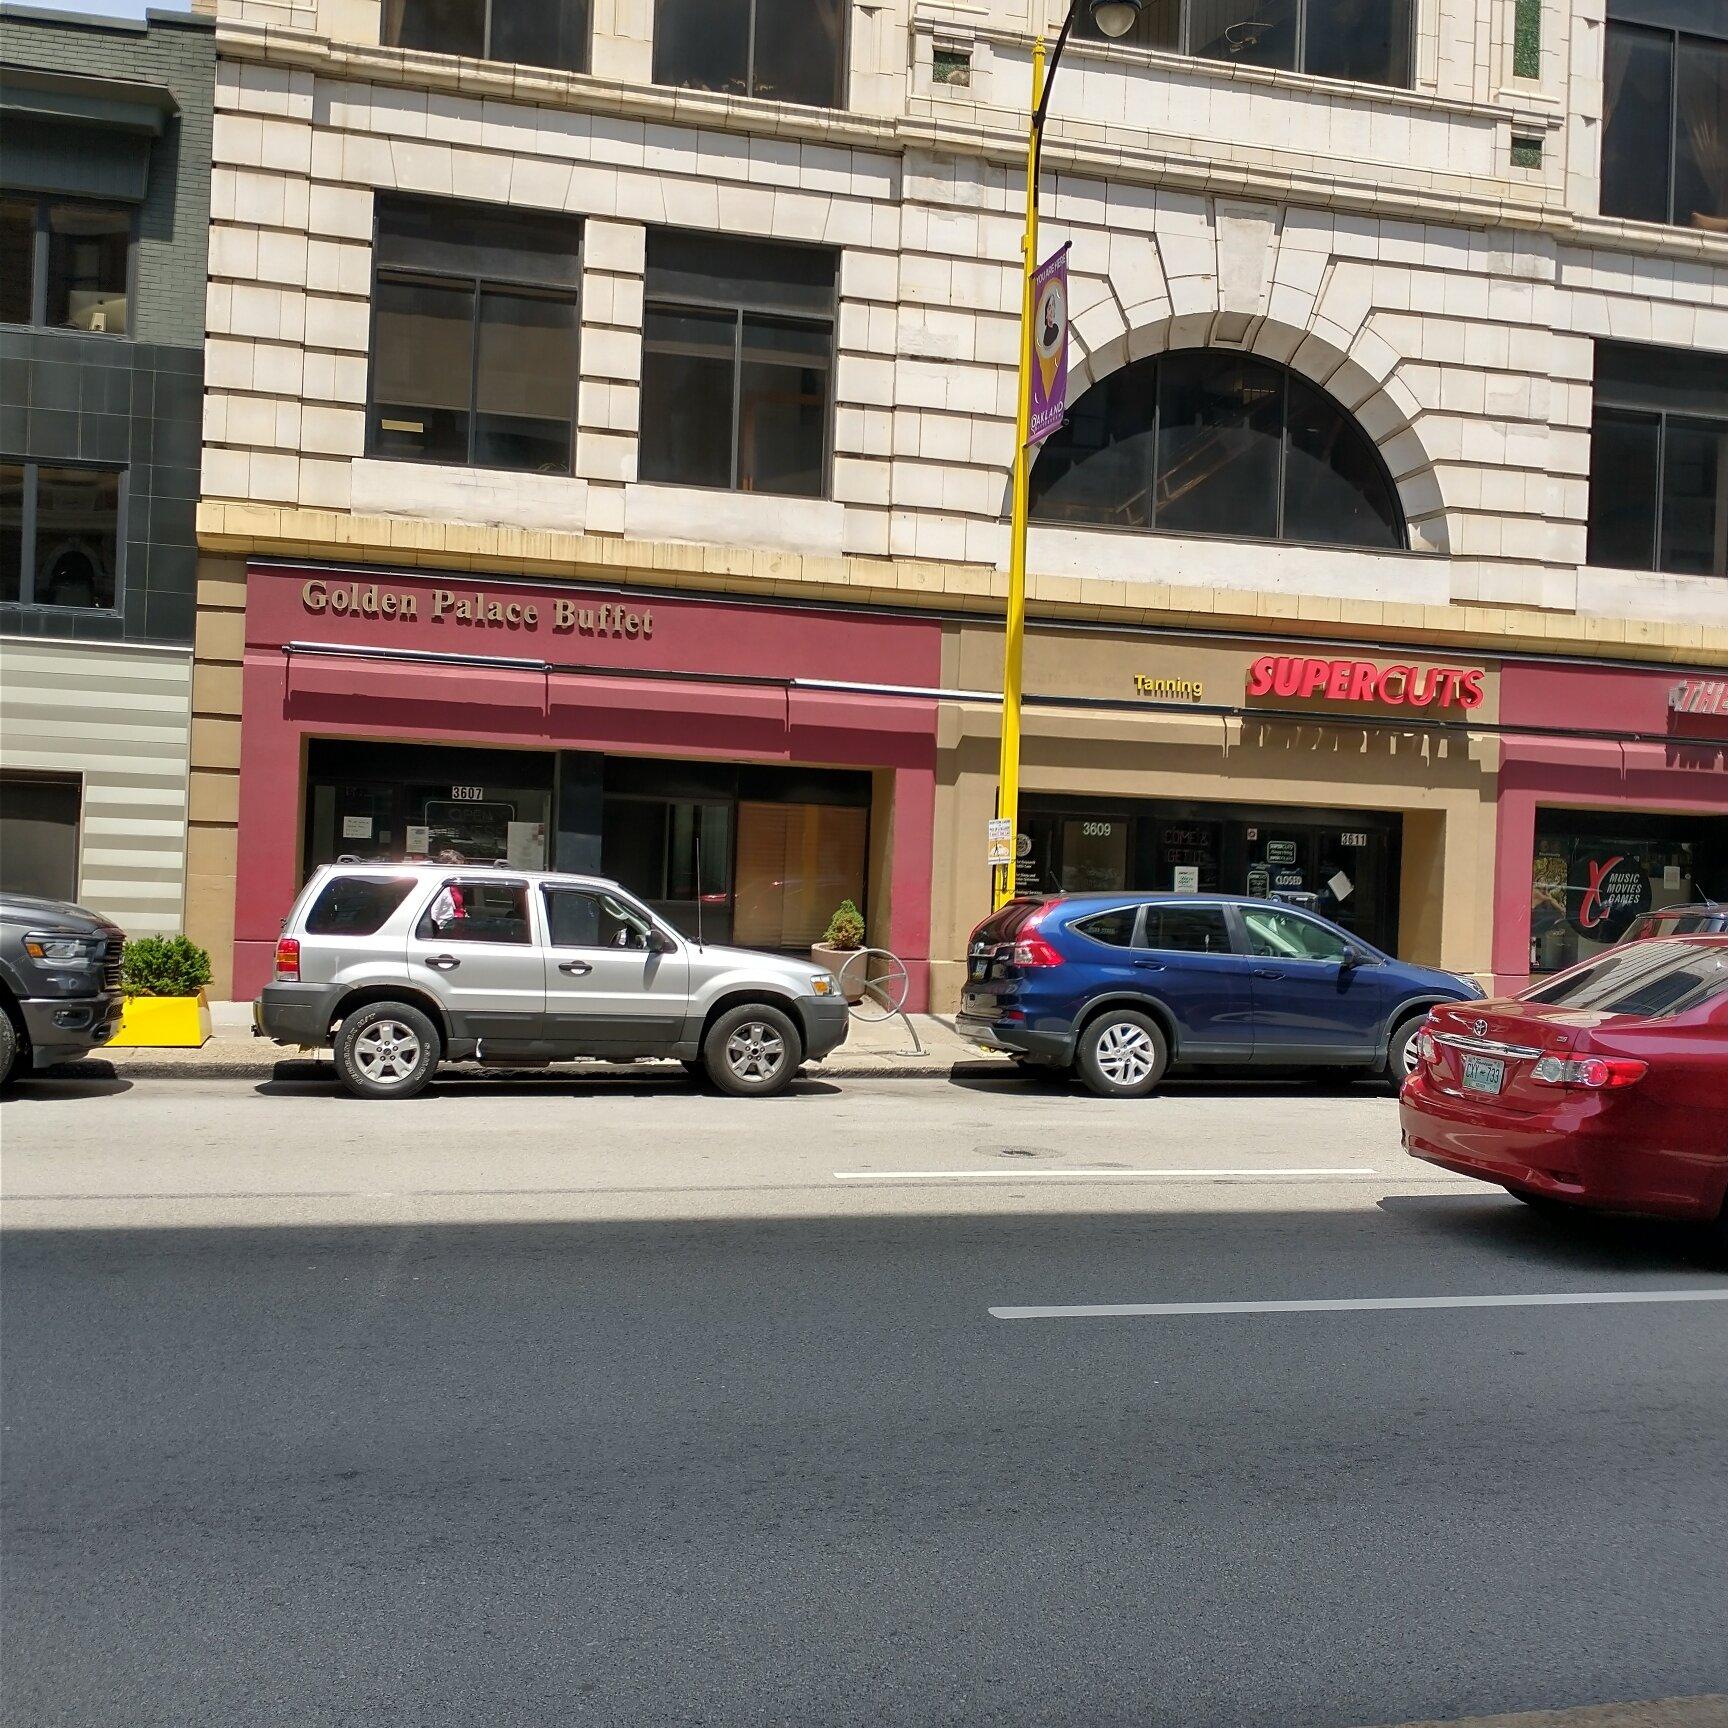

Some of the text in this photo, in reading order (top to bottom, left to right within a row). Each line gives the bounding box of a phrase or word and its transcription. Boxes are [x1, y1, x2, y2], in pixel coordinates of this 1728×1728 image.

[1036, 253, 1066, 285] YOU ARE HERE
[1031, 401, 1064, 428] OAKLAND
[302, 579, 653, 633] Golden Palace Buffet
[1134, 674, 1203, 696] Tanning
[1249, 655, 1486, 709] SUPERCUTS
[453, 786, 482, 800] 3607
[1082, 822, 1112, 836] 3609
[1341, 833, 1366, 846] 3611
[1275, 876, 1302, 886] CLOSED
[1609, 873, 1640, 883] MUSIC
[1606, 883, 1642, 894] MOVIES
[1608, 894, 1640, 904] GAMES
